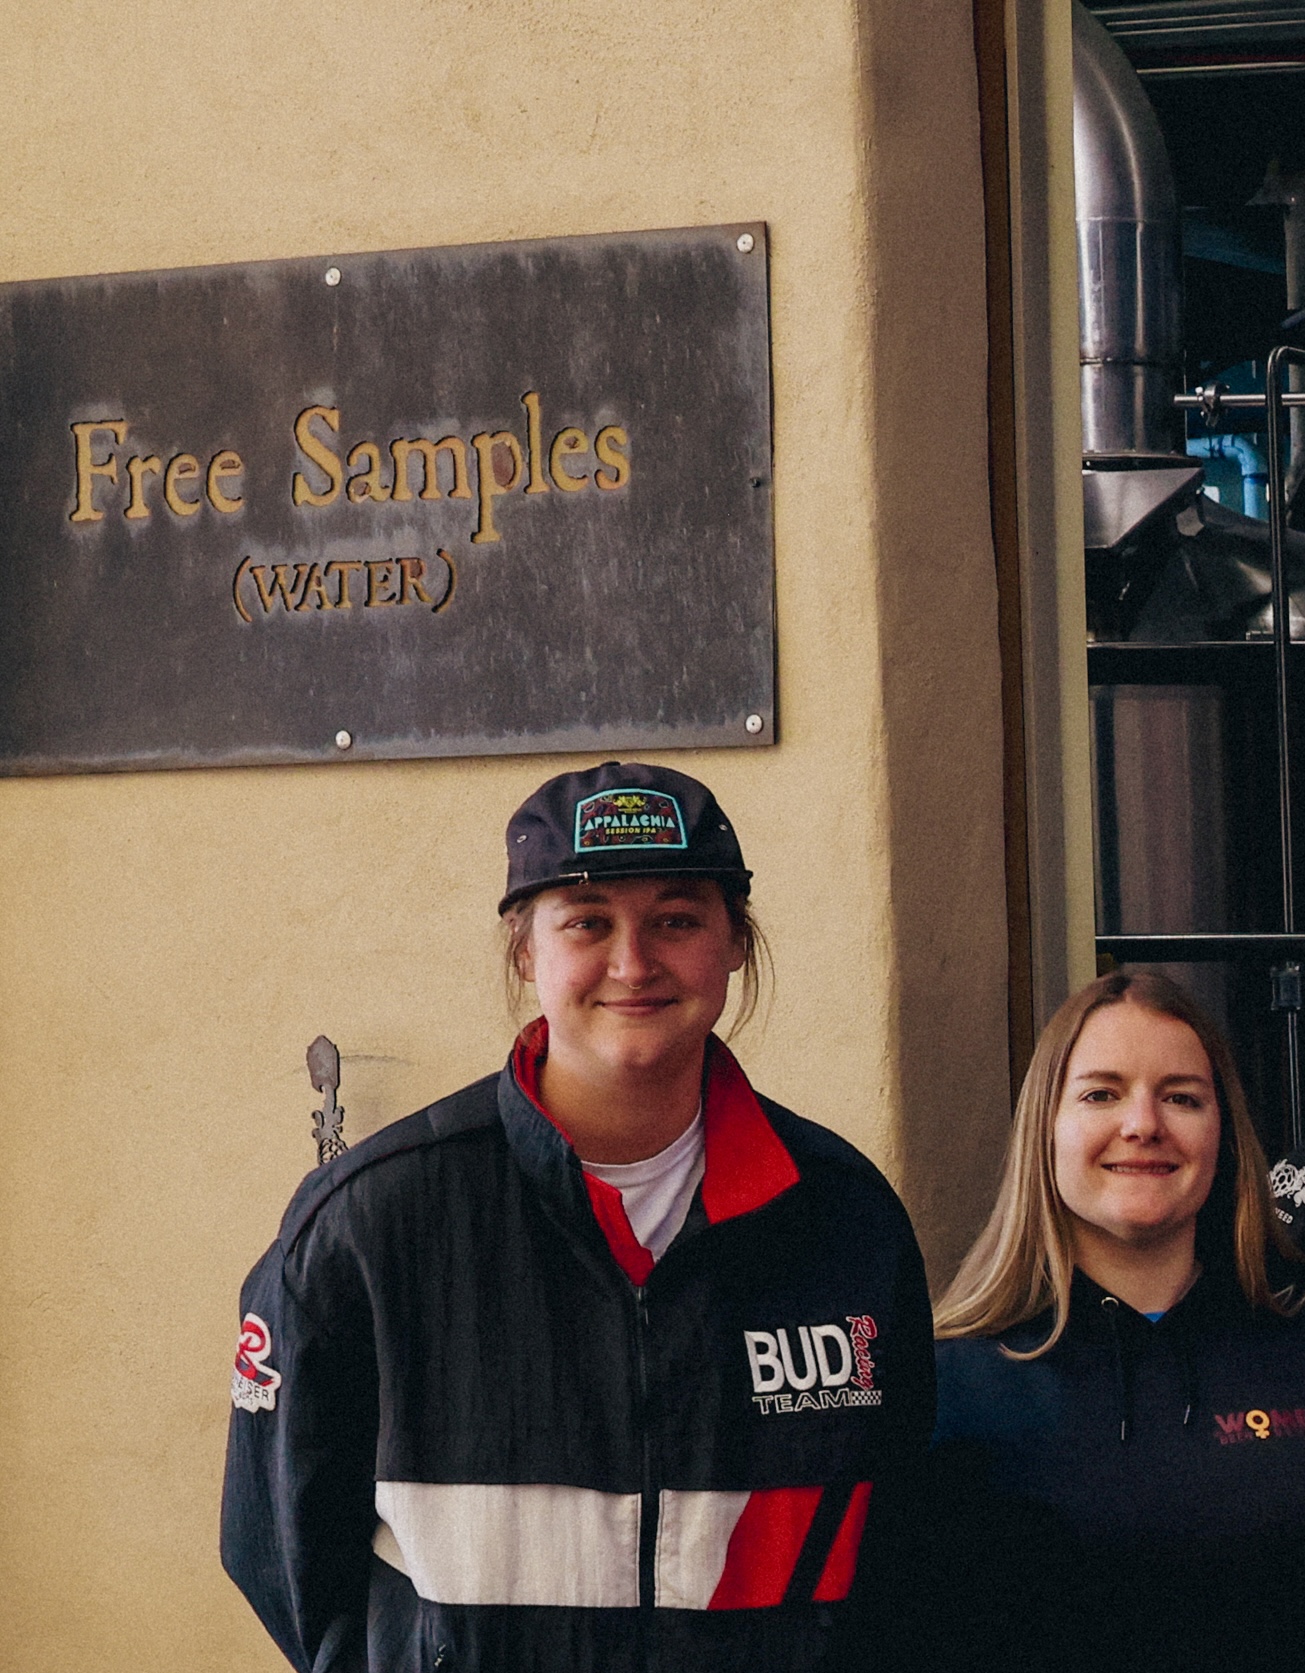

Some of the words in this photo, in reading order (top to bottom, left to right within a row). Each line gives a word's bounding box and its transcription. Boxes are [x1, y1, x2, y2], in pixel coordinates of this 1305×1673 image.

[69, 419, 243, 523] Free
[292, 391, 632, 544] Samples
[232, 549, 459, 623] (WATER)
[584, 814, 675, 831] APPALACHIA
[605, 827, 640, 835] SESSION
[743, 1324, 852, 1393] BUD
[846, 1315, 878, 1391] Racing
[752, 1387, 851, 1415] TEAM
